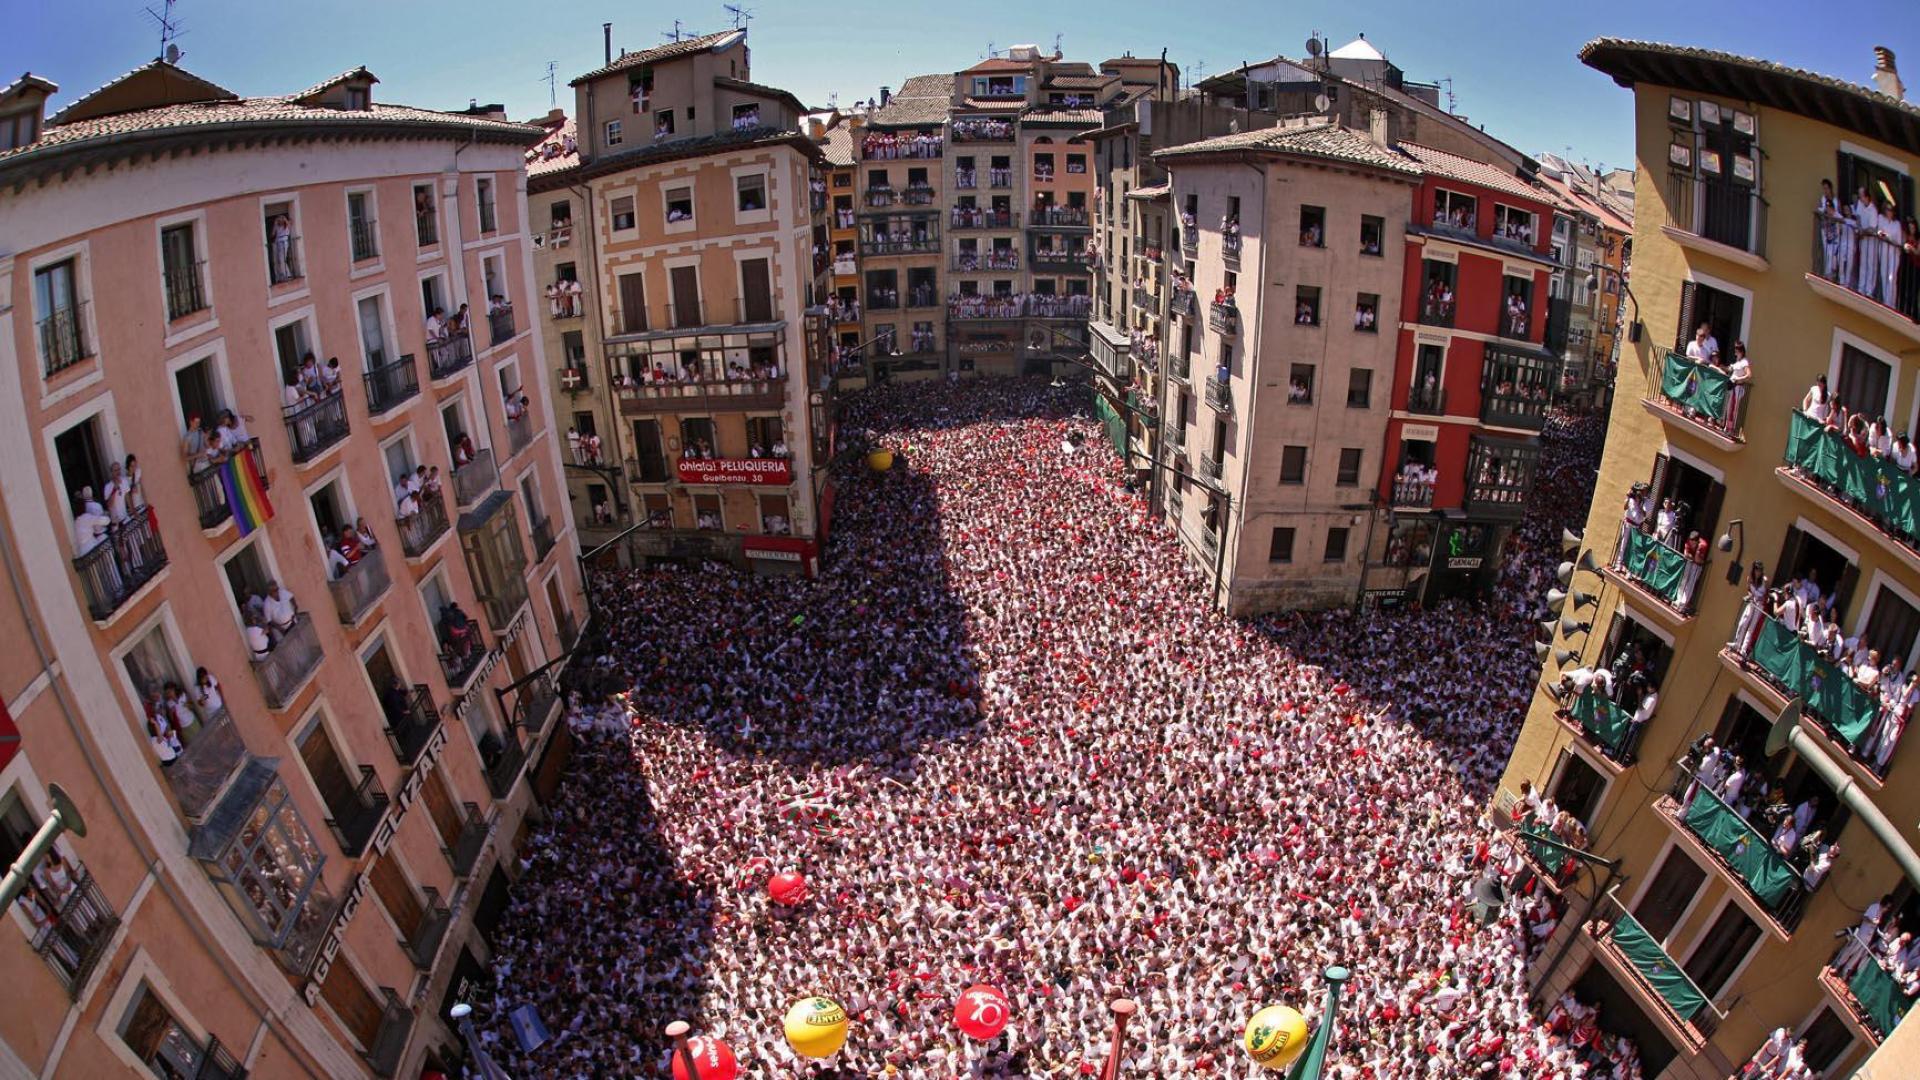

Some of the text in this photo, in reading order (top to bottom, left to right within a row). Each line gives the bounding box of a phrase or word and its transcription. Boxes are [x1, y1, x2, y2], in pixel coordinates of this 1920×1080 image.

[720, 460, 786, 472] PELUQUERIA
[752, 473, 763, 482] 30
[305, 872, 370, 1007] AGENCIA
[374, 722, 448, 857] ELIZARI
